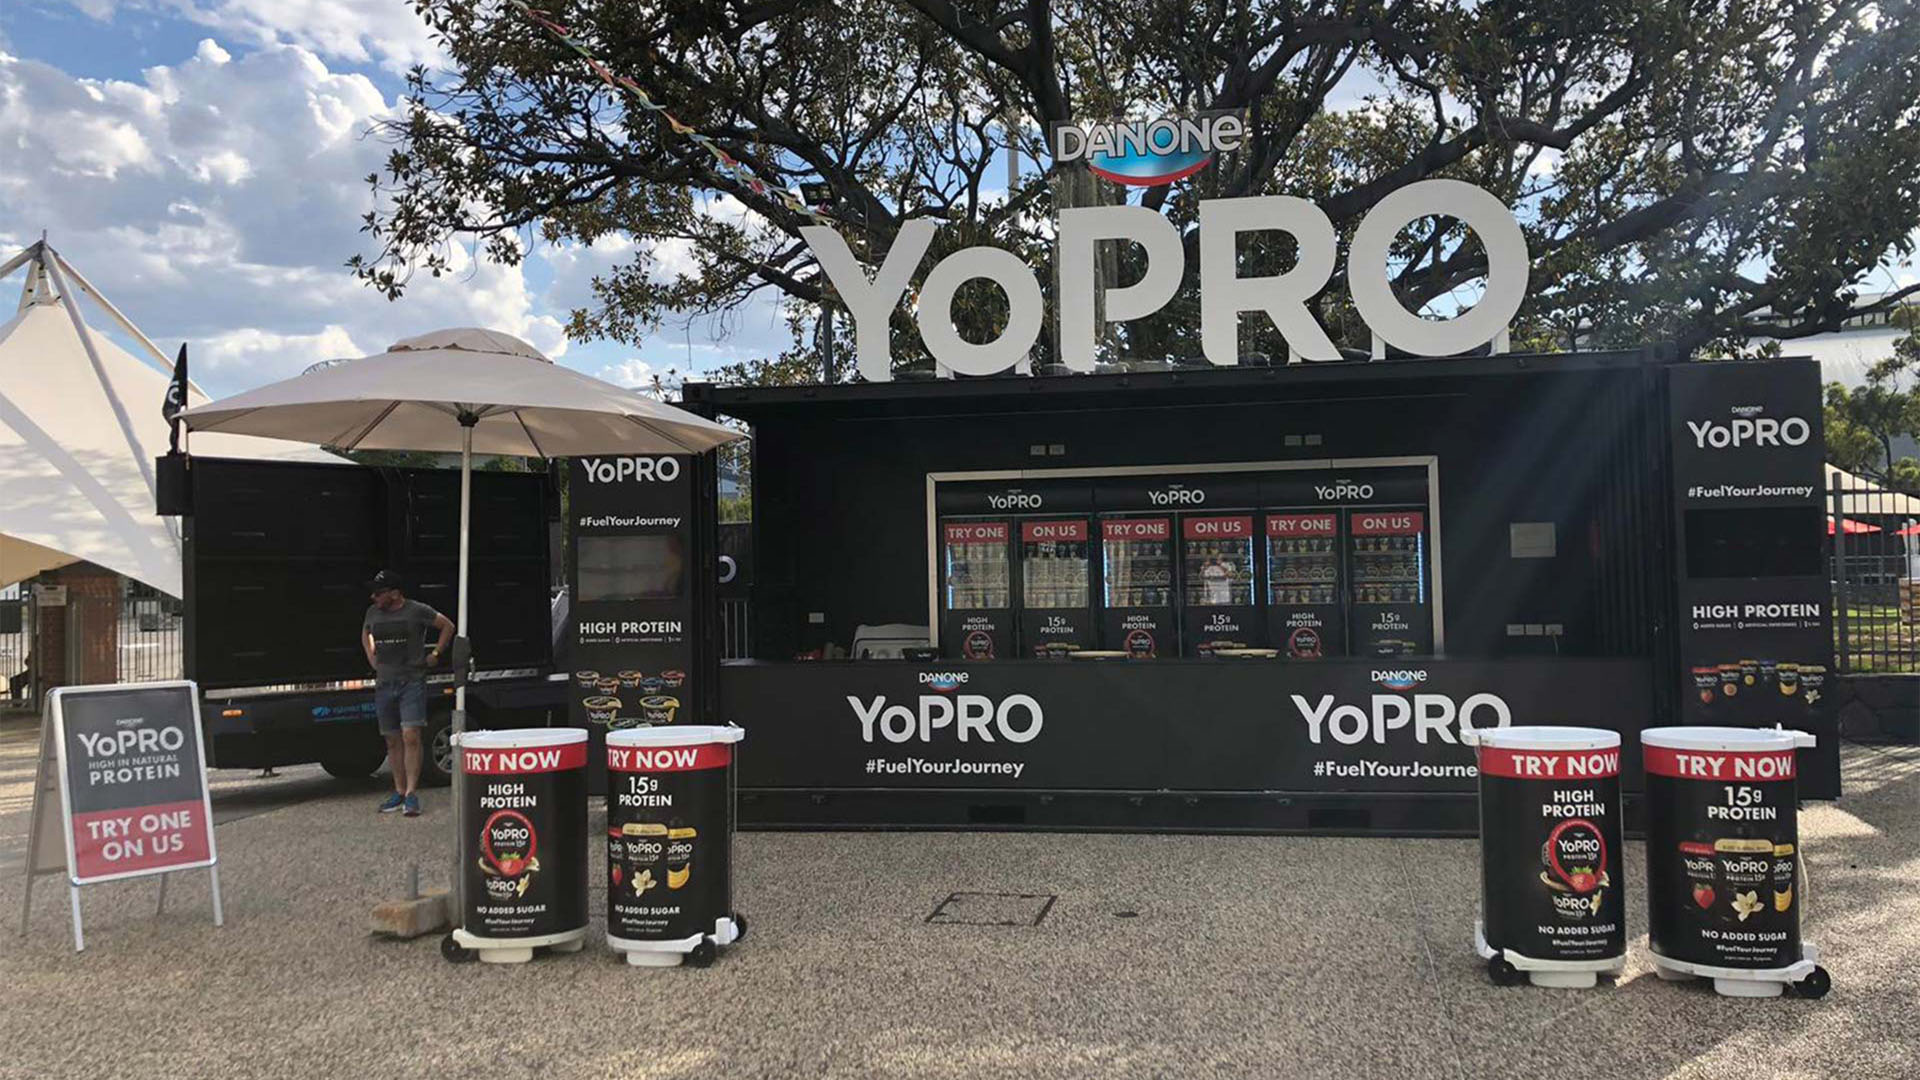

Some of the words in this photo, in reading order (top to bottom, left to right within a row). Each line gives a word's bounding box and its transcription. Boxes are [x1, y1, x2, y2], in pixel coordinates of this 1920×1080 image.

[799, 179, 1530, 383] YoPRO
[1687, 417, 1810, 448] YoPRO
[580, 456, 680, 483] YoPRO
[1148, 489, 1205, 504] YoPRO
[1315, 484, 1374, 500] YoPRO
[1688, 485, 1813, 498] #FuelYourJourney
[988, 494, 1042, 509] YoPRO
[580, 516, 681, 527] #FuelYourJourney
[1195, 522, 1219, 533] ON
[1223, 521, 1241, 532] US
[1270, 520, 1296, 531] TRY
[1300, 519, 1332, 530] ONE
[1363, 518, 1387, 529] ON
[1392, 517, 1411, 528] US
[949, 528, 972, 538] TRY
[976, 527, 1004, 538] ONE
[1032, 526, 1056, 537] ON
[1059, 525, 1077, 536] US
[1106, 525, 1131, 535] TRY
[1134, 524, 1165, 534] ONE
[1692, 605, 1738, 618] HIGH
[1744, 604, 1820, 617] PROTEIN
[580, 622, 616, 634] HIGH
[621, 621, 682, 633] PROTEIN
[1122, 622, 1156, 630] PROTEIN
[846, 693, 1044, 743] YoPRO
[1290, 692, 1512, 745] YoPRO
[78, 726, 184, 758] YoPRO
[88, 760, 115, 770] HIGH
[118, 758, 129, 768] IN
[132, 754, 178, 765] NATURAL
[466, 752, 494, 771] TRY
[499, 750, 561, 771] NOW
[608, 749, 630, 768] TRY
[636, 748, 698, 769] NOW
[1511, 755, 1560, 776] TRY
[1567, 752, 1618, 775] NOW
[866, 757, 1024, 778] #FuelYourJourney
[1313, 759, 1478, 778] #FuelYourJourne
[1676, 755, 1726, 777] TRY
[1735, 755, 1793, 778] NOW
[89, 763, 180, 786] PROTEIN
[488, 783, 524, 796] HIGH
[629, 776, 658, 795] 15g
[480, 796, 537, 808] PROTEIN
[619, 794, 672, 807] PROTEIN
[1553, 789, 1594, 803] HIGH
[1724, 786, 1762, 807] 15g
[1542, 803, 1605, 817] PROTEIN
[1708, 806, 1776, 820] PROTEIN
[87, 817, 133, 840] TRY
[139, 810, 192, 834] ONE
[491, 828, 529, 840] YoPRO
[102, 840, 143, 862] ON
[152, 833, 184, 855] US
[626, 842, 662, 854] YoPRO
[1558, 839, 1599, 853] YoPRO
[1684, 858, 1715, 872] YoPR
[1722, 859, 1768, 873] YoPRO
[477, 905, 487, 914] NO
[488, 906, 515, 915] ADDED
[516, 904, 546, 914] SUGAR
[625, 906, 649, 915] ADDED
[651, 906, 680, 915] SUGAR
[1538, 925, 1555, 935] NO
[1557, 926, 1589, 935] ADDED
[1590, 924, 1615, 934] SUGAR
[1701, 929, 1719, 939] NO
[1721, 932, 1756, 941] ADDED
[1758, 931, 1787, 941] SUGAR
